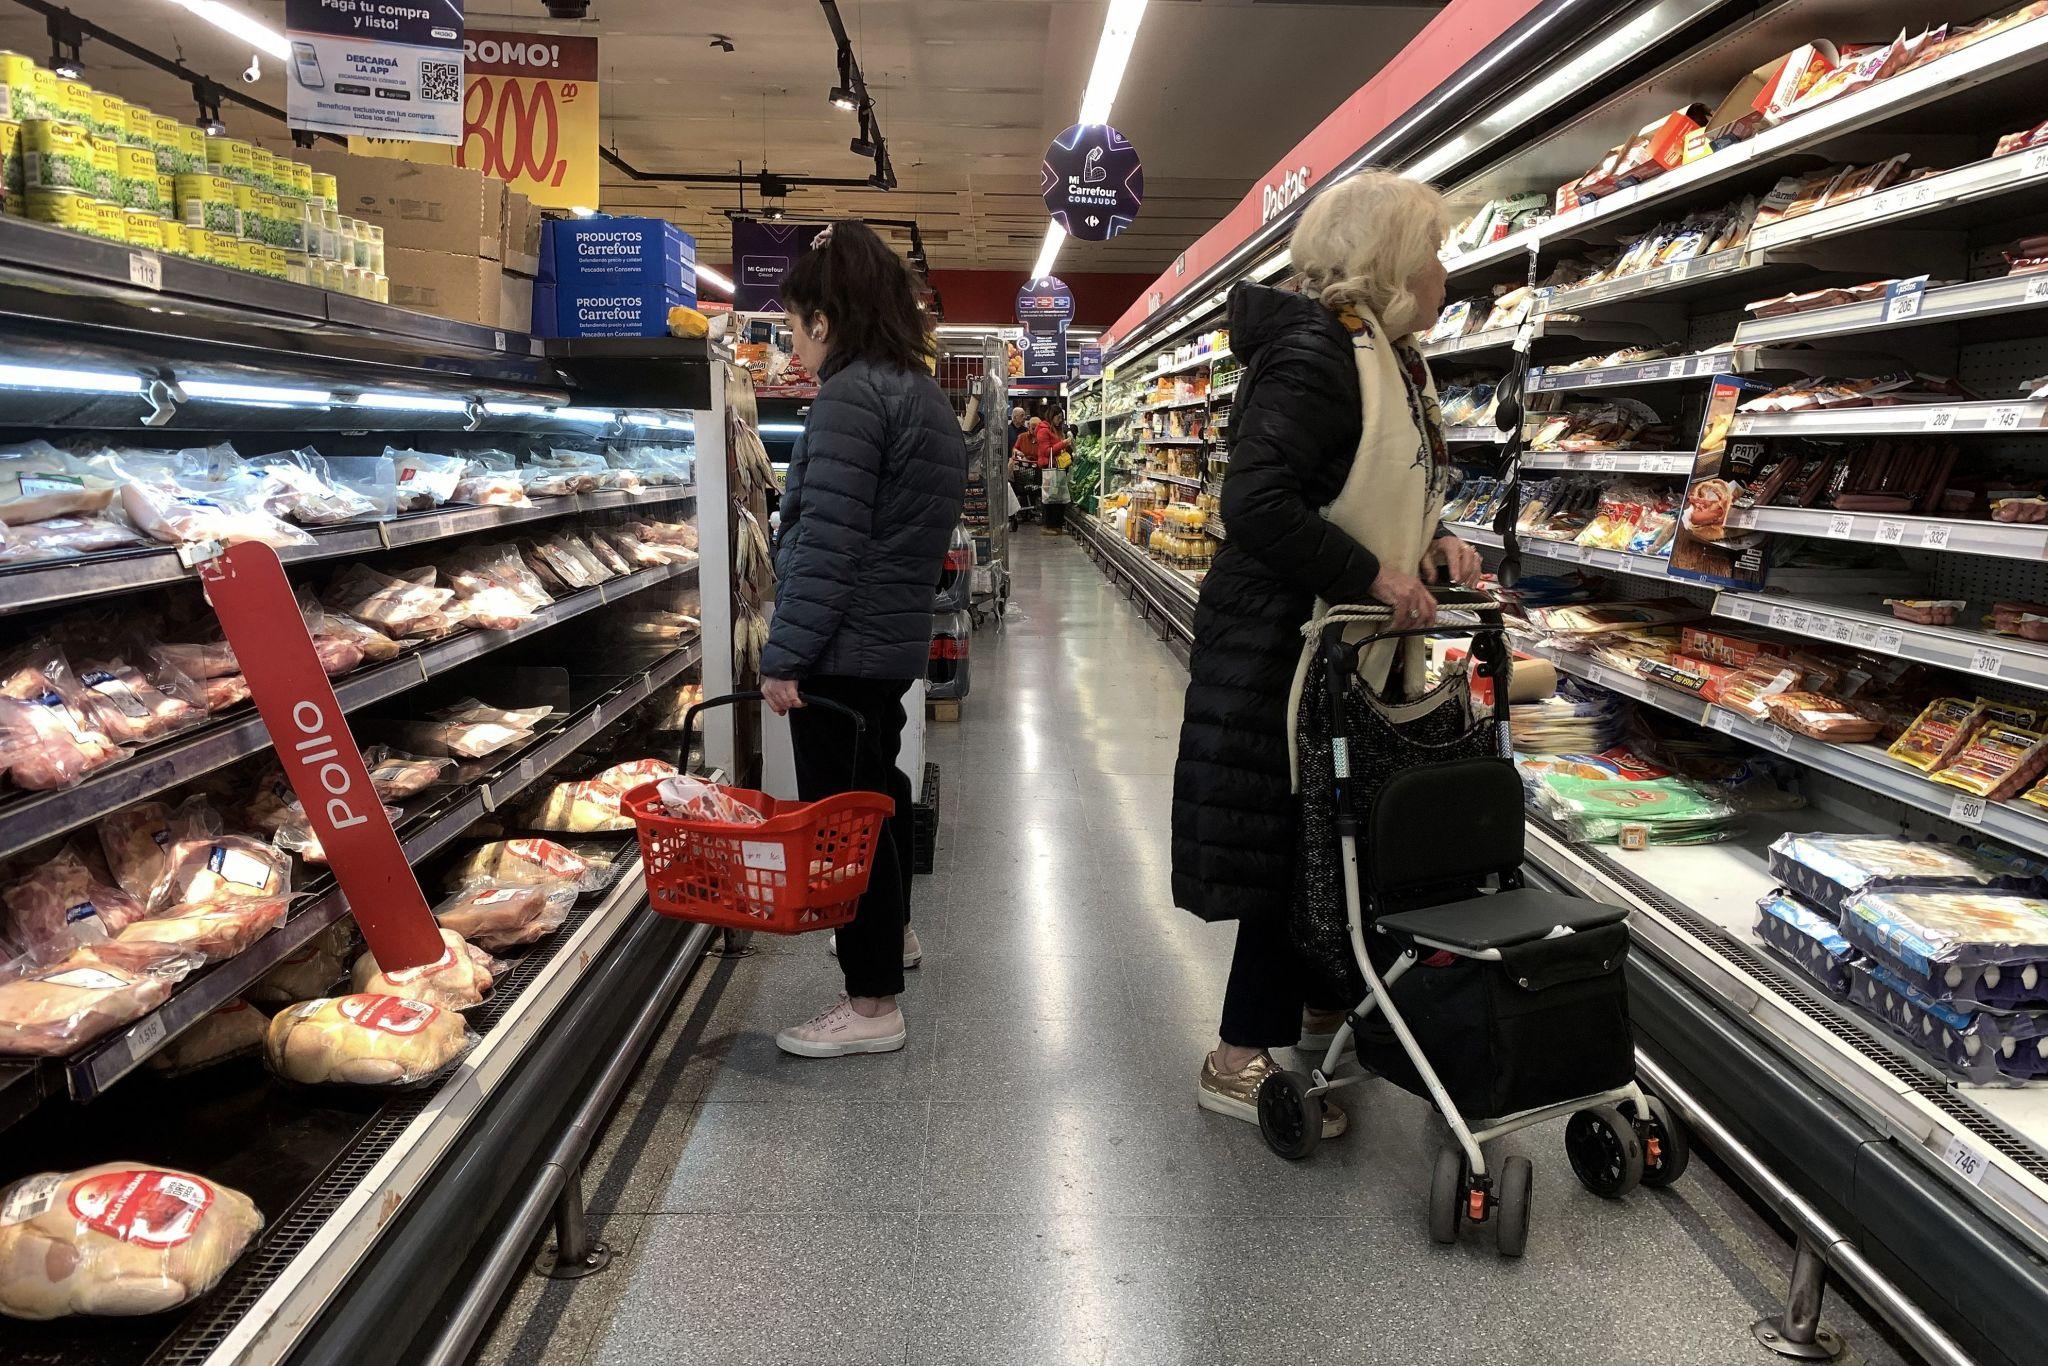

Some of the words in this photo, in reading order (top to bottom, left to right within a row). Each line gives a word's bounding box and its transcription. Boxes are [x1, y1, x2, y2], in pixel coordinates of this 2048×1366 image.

[360, 0, 374, 12] tu
[378, 3, 430, 20] compra
[353, 15, 362, 28] y
[365, 15, 399, 30] listo!
[346, 54, 398, 67] DESCARGÁ
[355, 64, 368, 73] LA
[370, 65, 389, 75] APP
[317, 102, 351, 111] Beneficios
[352, 106, 386, 116] exclusivos
[408, 112, 435, 121] compras
[354, 112, 373, 121] todos
[373, 114, 383, 122] los
[1068, 176, 1079, 184] Mi
[1068, 185, 1116, 197] Carrefour
[1262, 165, 1311, 226] Pastas
[1068, 195, 1117, 206] CORAJUDO
[576, 232, 643, 242] PRODUCTOS
[578, 242, 642, 256] Carrefour
[577, 297, 643, 307] PRODUCTOS
[1898, 299, 1912, 314] 206
[579, 307, 642, 320] Carrefour
[1933, 413, 1949, 426] 209
[2000, 412, 2014, 426] 145
[1735, 445, 1759, 459] PATY
[1834, 520, 1847, 533] 222
[1885, 527, 1898, 540] 309
[1930, 530, 1944, 544] 332
[1979, 655, 1996, 671] 310
[292, 700, 368, 830] Pollo
[1963, 803, 1979, 818] 600
[1955, 1150, 1976, 1174] 746
[172, 1183, 185, 1197] DRY
